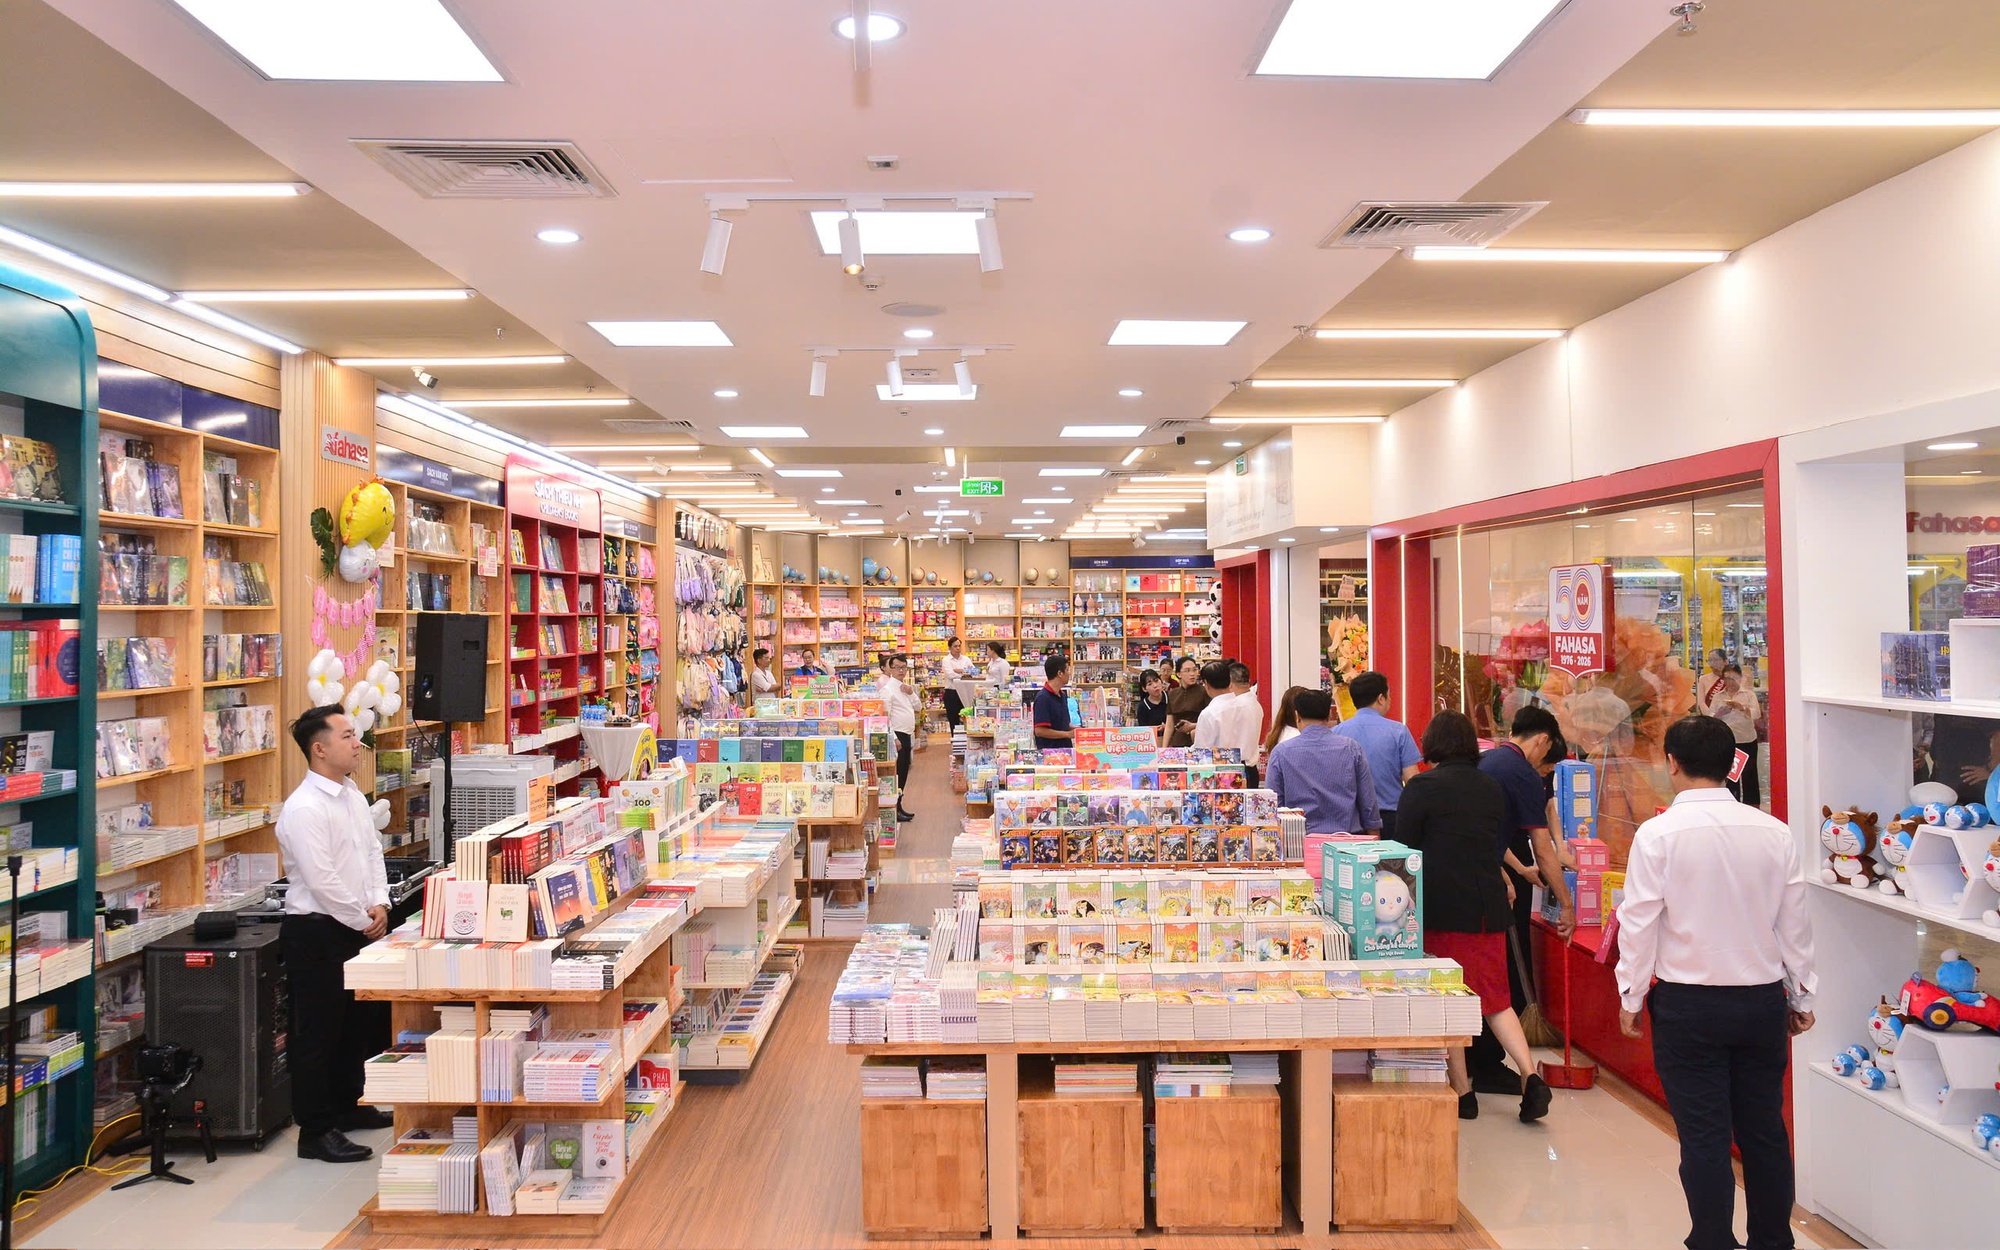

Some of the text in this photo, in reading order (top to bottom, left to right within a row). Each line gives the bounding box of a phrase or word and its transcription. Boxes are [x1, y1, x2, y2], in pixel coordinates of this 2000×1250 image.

[534, 478, 552, 500] SÁCH
[1906, 512, 2000, 533] Fahasa
[1556, 568, 1596, 631] 50
[1578, 594, 1588, 606] NĂM
[1555, 636, 1596, 655] FAHASA
[1560, 655, 1573, 665] 1976
[1577, 656, 1592, 666] 2026
[1106, 744, 1126, 754] Việt
[1137, 744, 1155, 752] Anh
